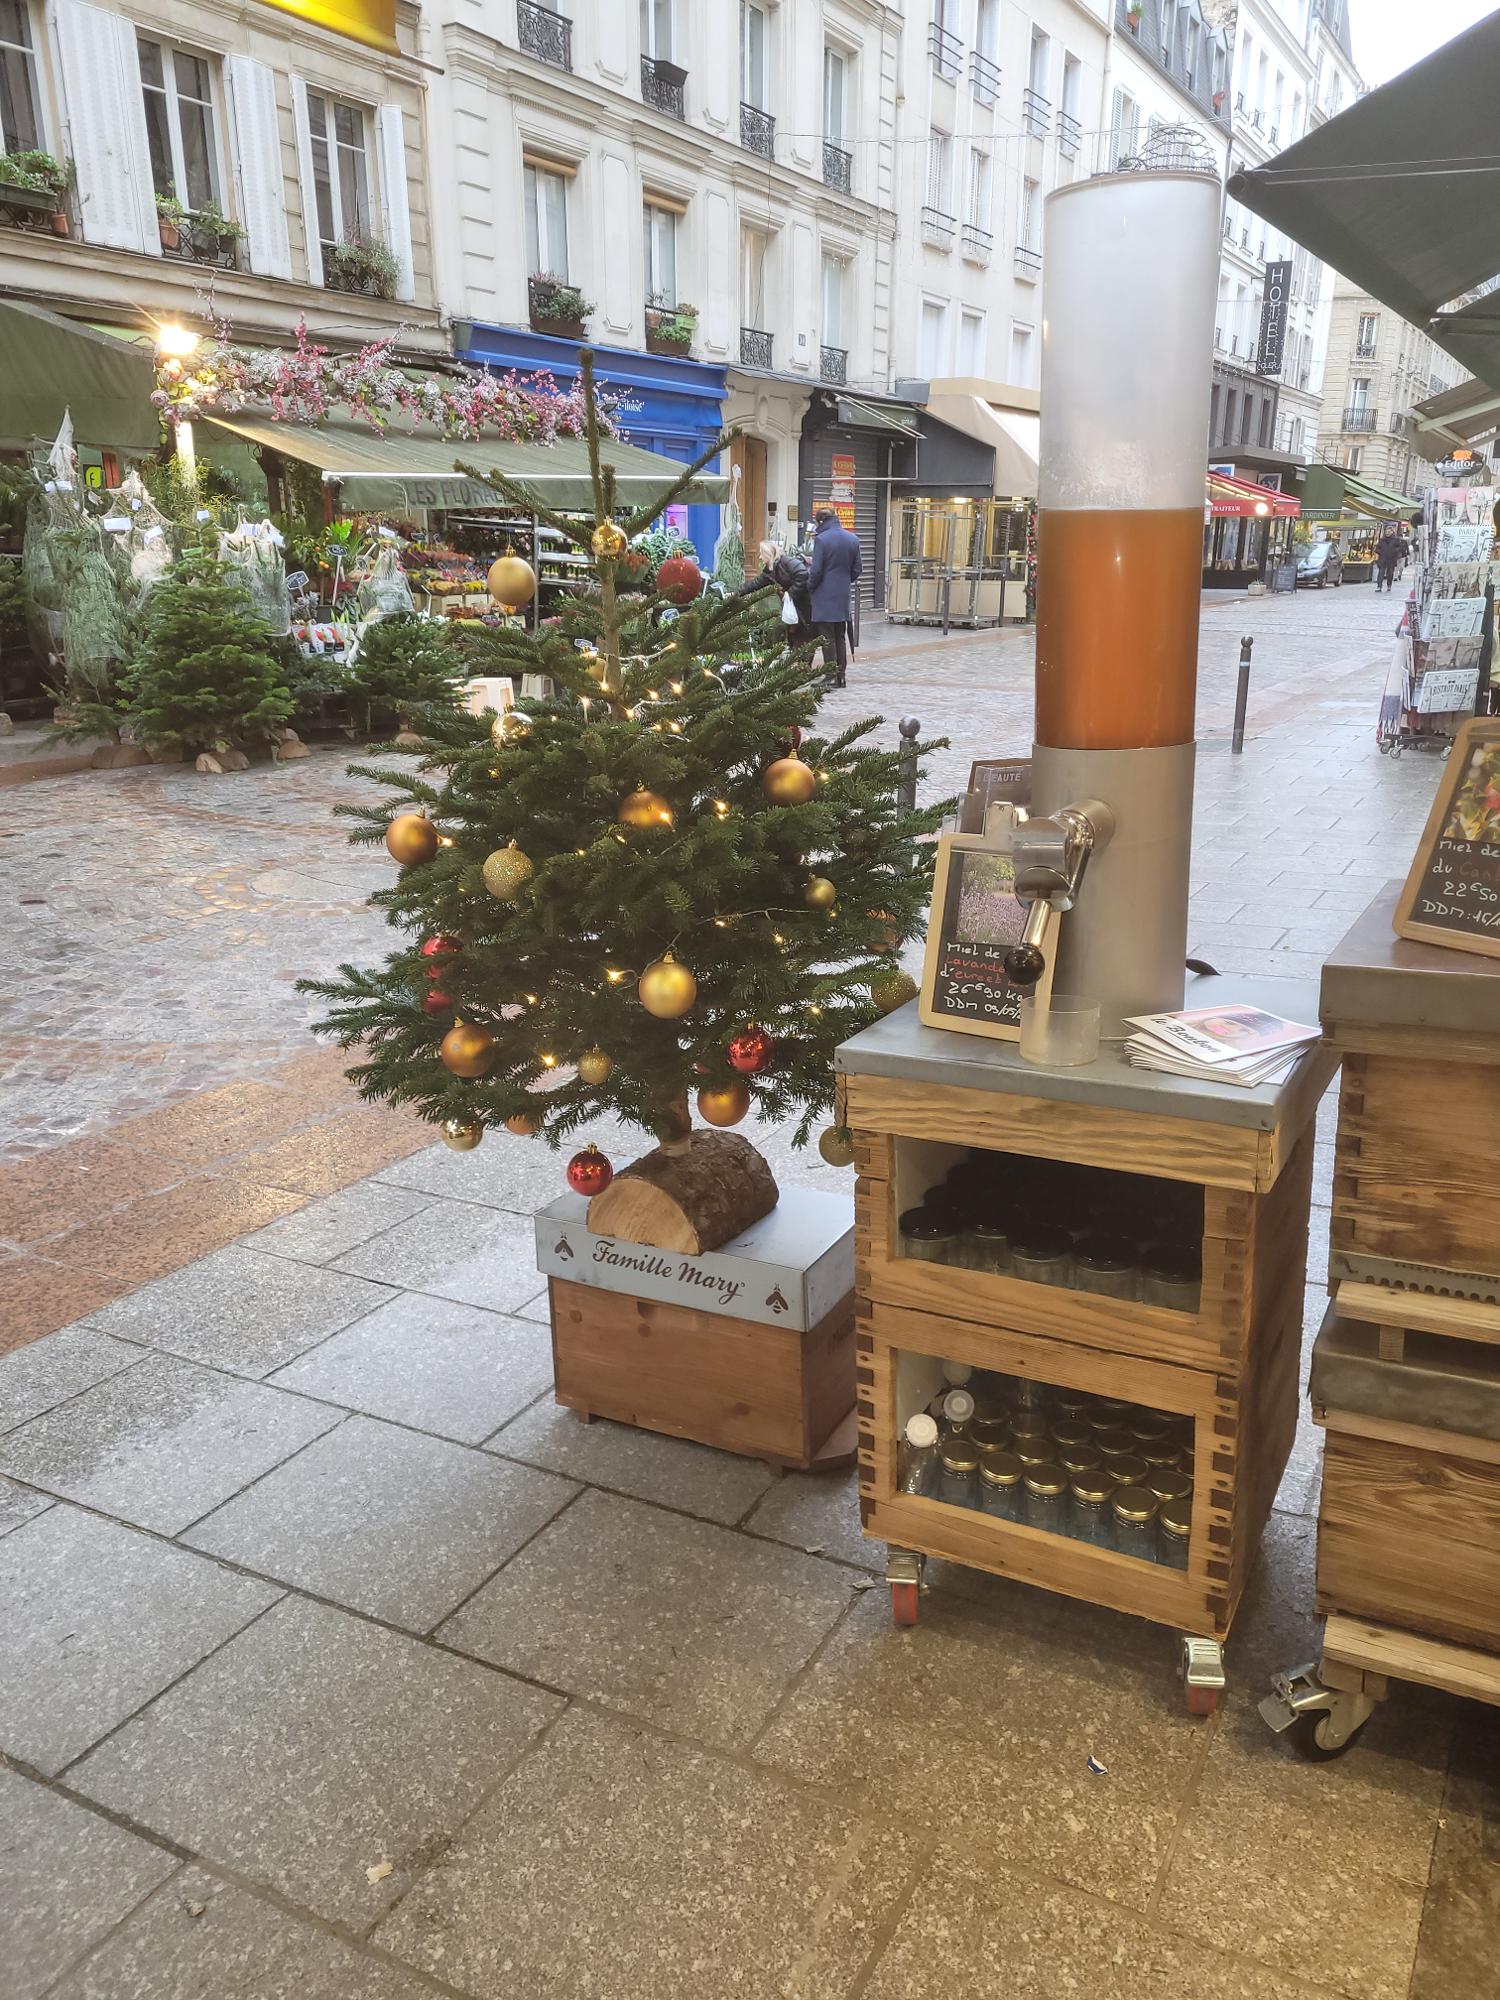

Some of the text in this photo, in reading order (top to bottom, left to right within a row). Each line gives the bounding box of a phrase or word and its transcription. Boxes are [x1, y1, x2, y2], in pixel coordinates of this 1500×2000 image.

[1266, 267, 1283, 356] HOTEL
[1439, 840, 1472, 853] Miel
[1432, 858, 1453, 873] du
[947, 942, 1001, 959] Miel de
[944, 996, 978, 1011] DDM
[1166, 1025, 1221, 1053] Bonbon
[592, 1240, 745, 1305] Famille Mary
